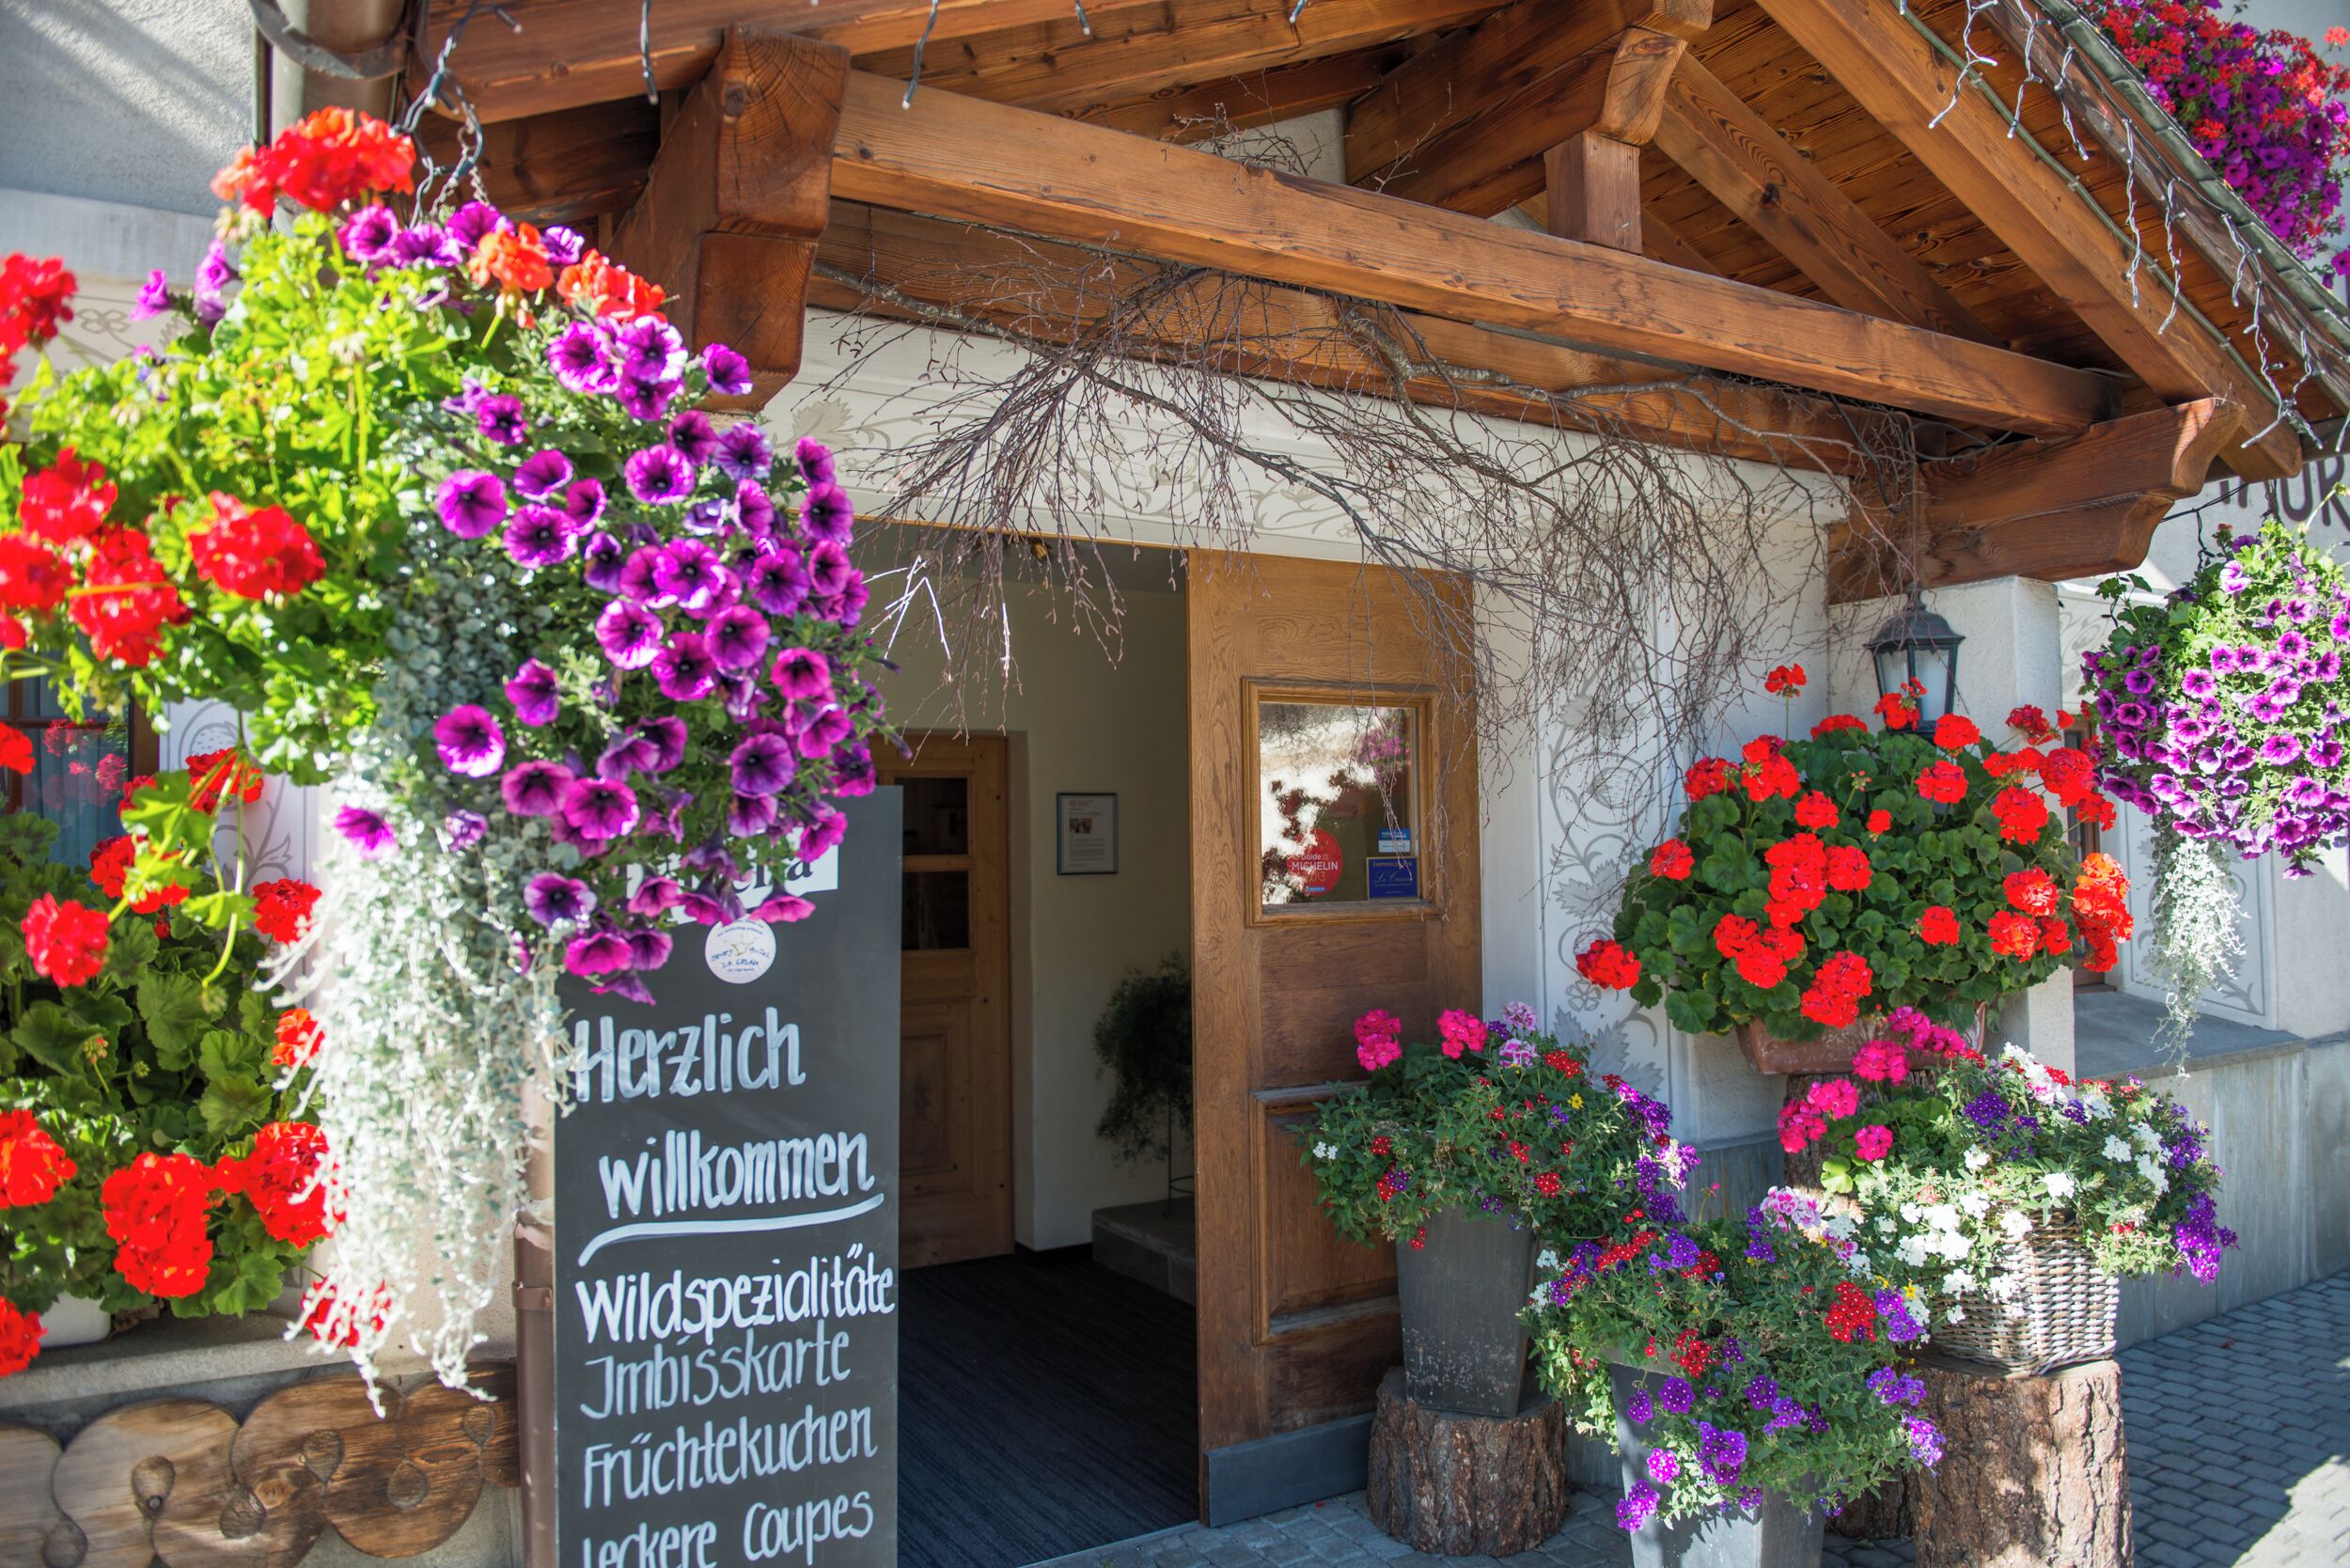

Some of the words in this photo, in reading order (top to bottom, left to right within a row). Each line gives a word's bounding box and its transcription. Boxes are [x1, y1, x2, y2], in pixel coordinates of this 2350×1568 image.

[1292, 861, 1339, 870] MICHELIN
[573, 1006, 807, 1104] Herzlich
[575, 1243, 896, 1345] Wildspezialitäte
[584, 1404, 878, 1510] Früchtekuchen
